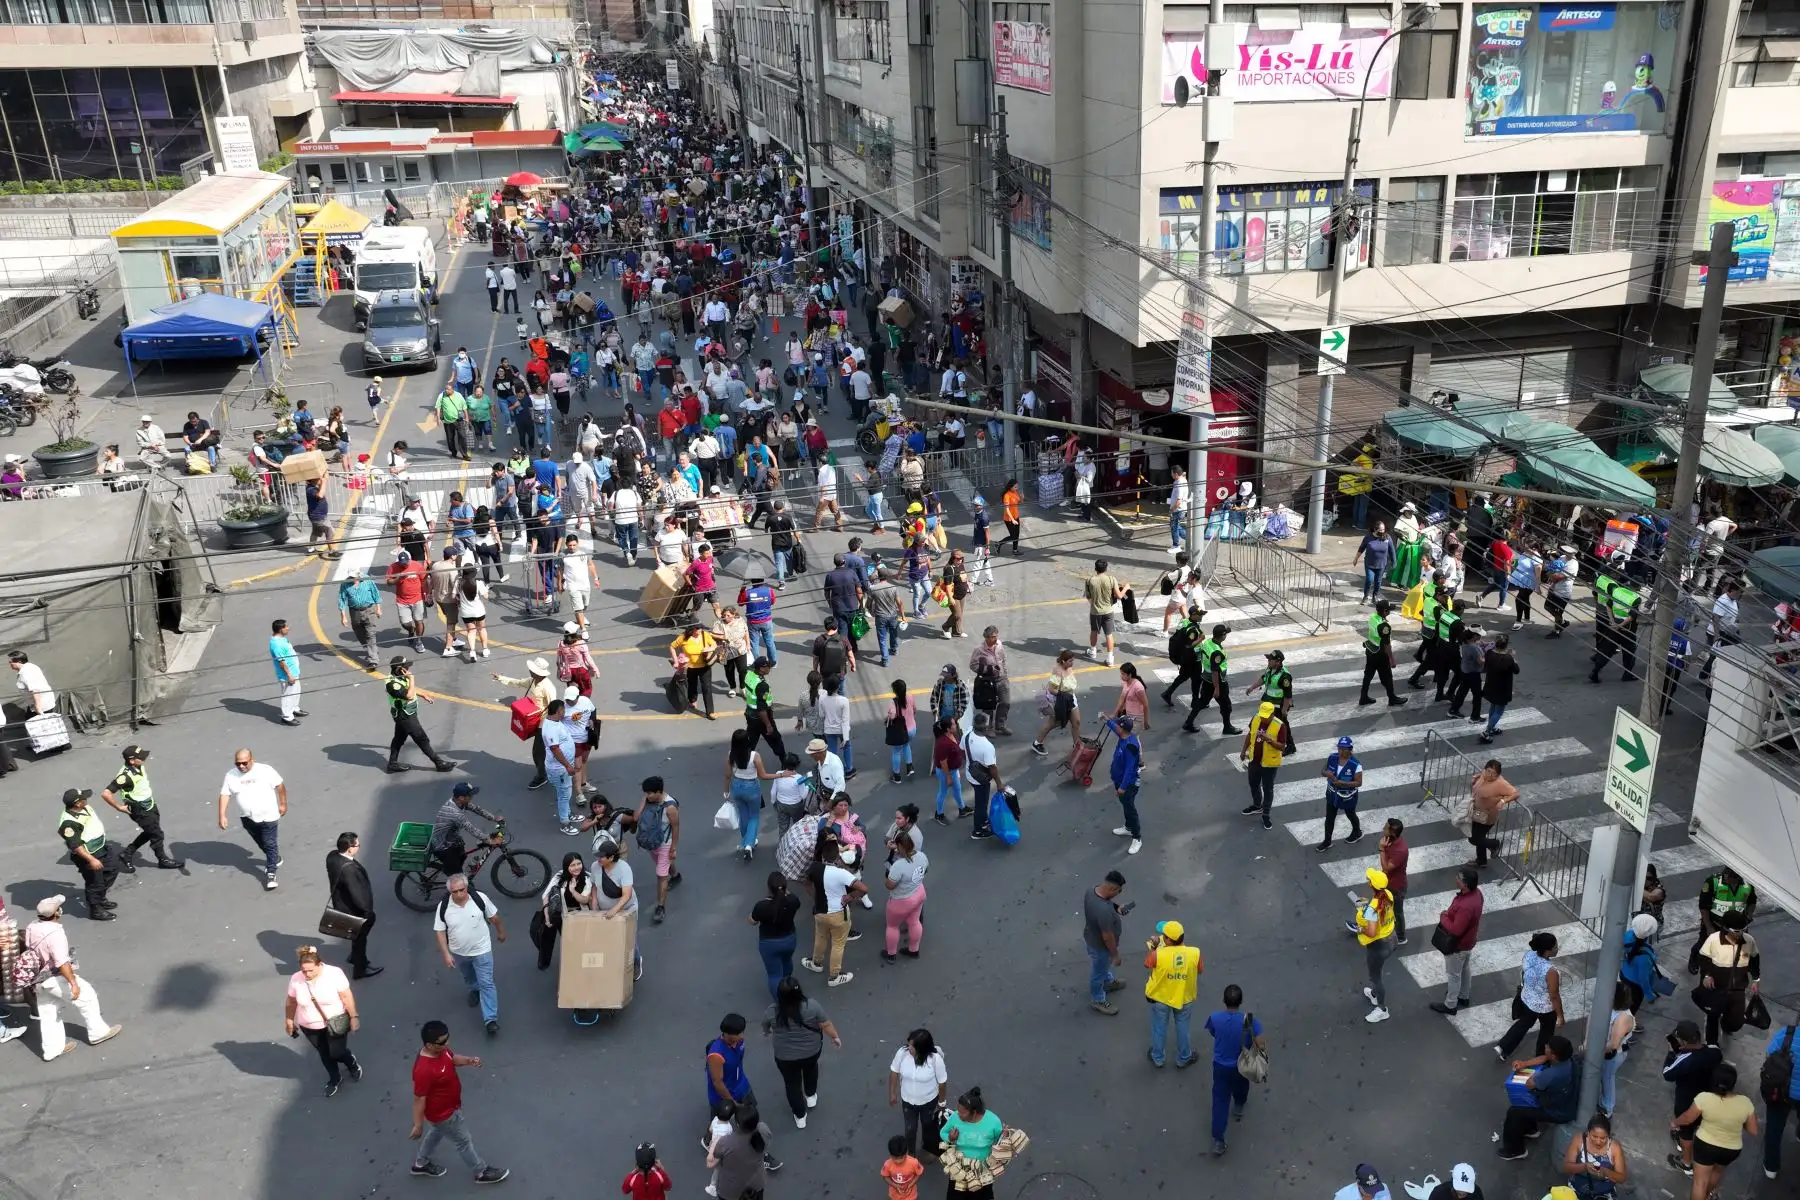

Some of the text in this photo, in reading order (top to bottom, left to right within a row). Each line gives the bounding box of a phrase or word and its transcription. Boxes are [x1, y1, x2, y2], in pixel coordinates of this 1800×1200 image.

[1556, 9, 1601, 19] ARTESCO
[1490, 20, 1523, 32] COLE
[1483, 37, 1522, 46] ARTESCO
[1237, 43, 1354, 71] Yis-Lú
[1238, 71, 1355, 86] IMPORTACIONES
[1544, 120, 1577, 128] AUTORIZADO
[1611, 775, 1642, 809] SALIDA
[1620, 806, 1635, 822] LIMA
[896, 1173, 903, 1182] 5
